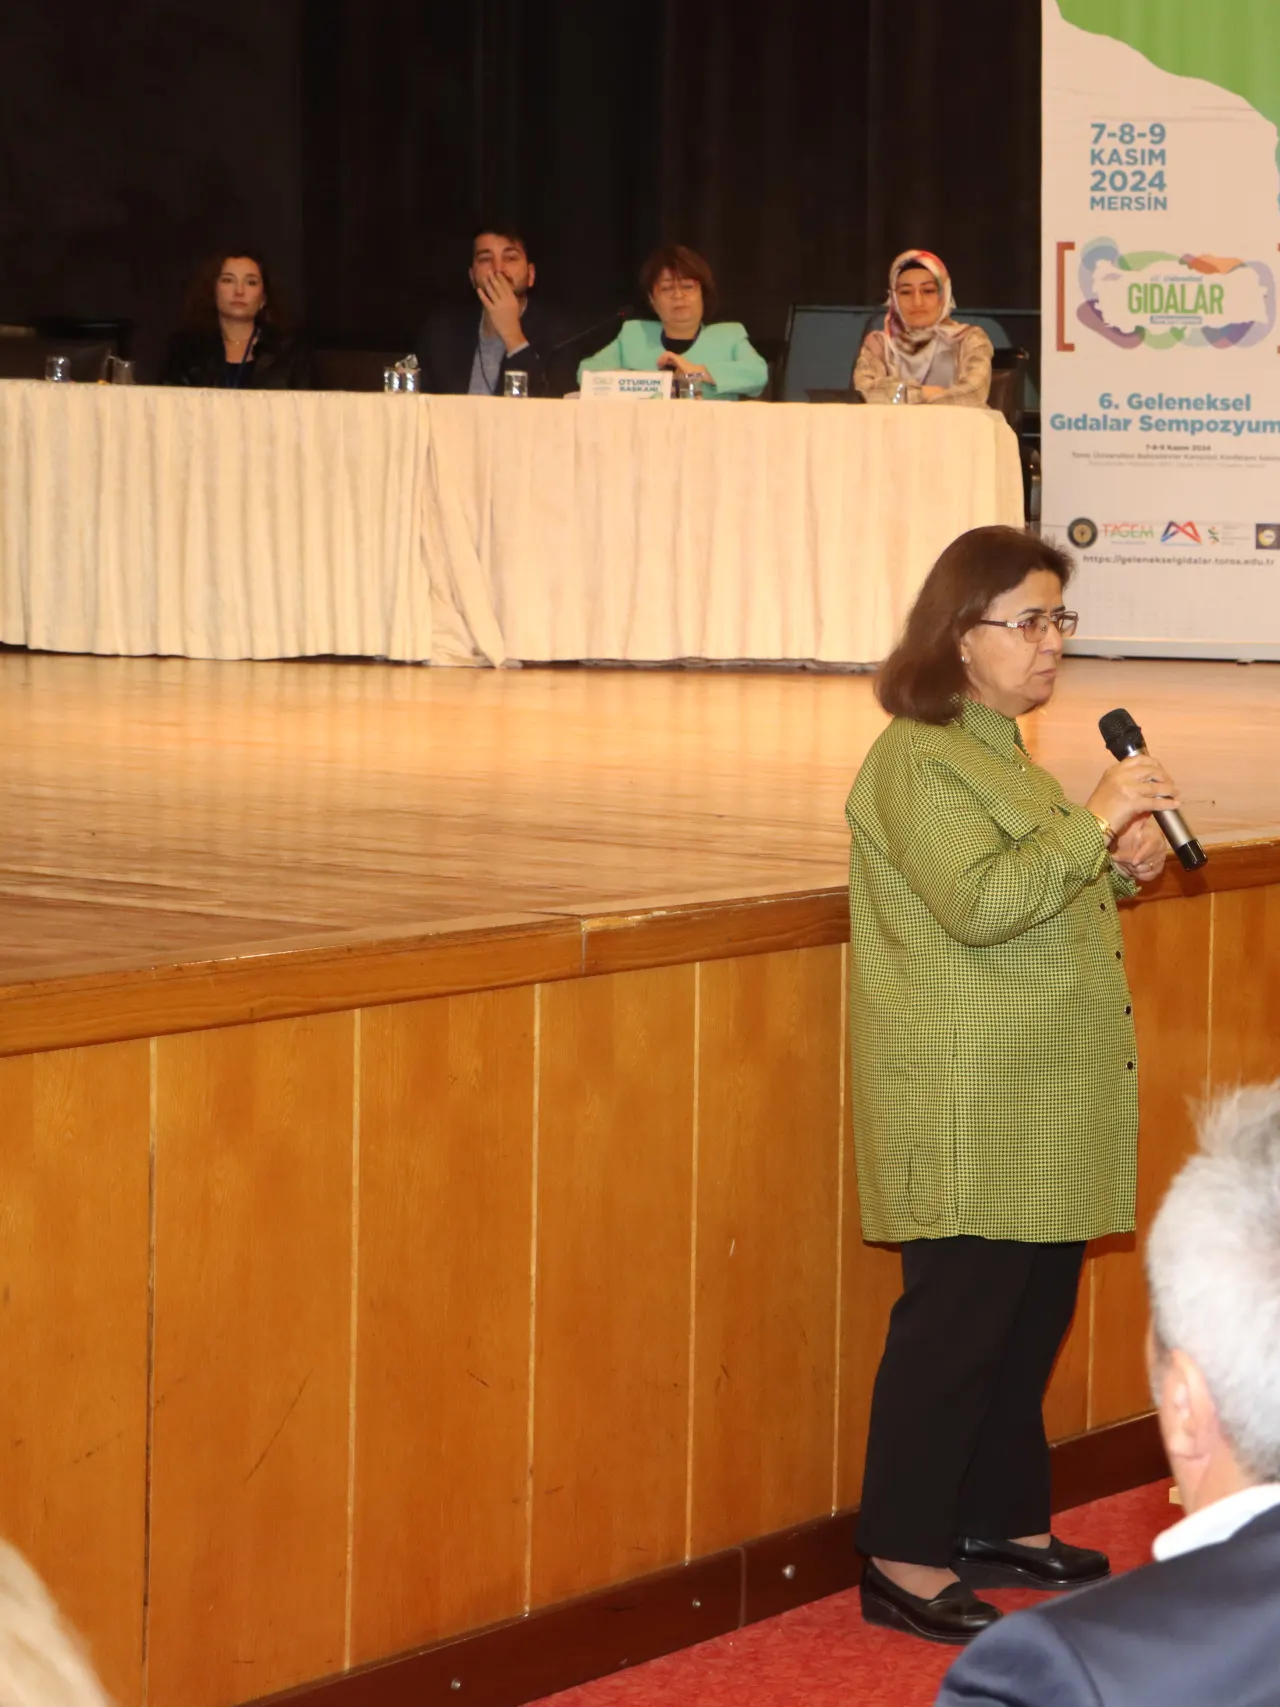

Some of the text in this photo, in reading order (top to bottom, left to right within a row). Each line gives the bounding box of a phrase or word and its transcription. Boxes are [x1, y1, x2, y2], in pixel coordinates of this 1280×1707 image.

[1090, 123, 1166, 145] 7-8-9
[1090, 149, 1166, 166] KASIM
[1090, 170, 1167, 192] 2024
[1090, 193, 1168, 211] MERSİN
[1128, 282, 1225, 315] GIDALAR
[1098, 393, 1252, 412] 6. Geleneksel
[1050, 413, 1132, 432] Gıdalar
[1102, 523, 1154, 538] TAGEM
